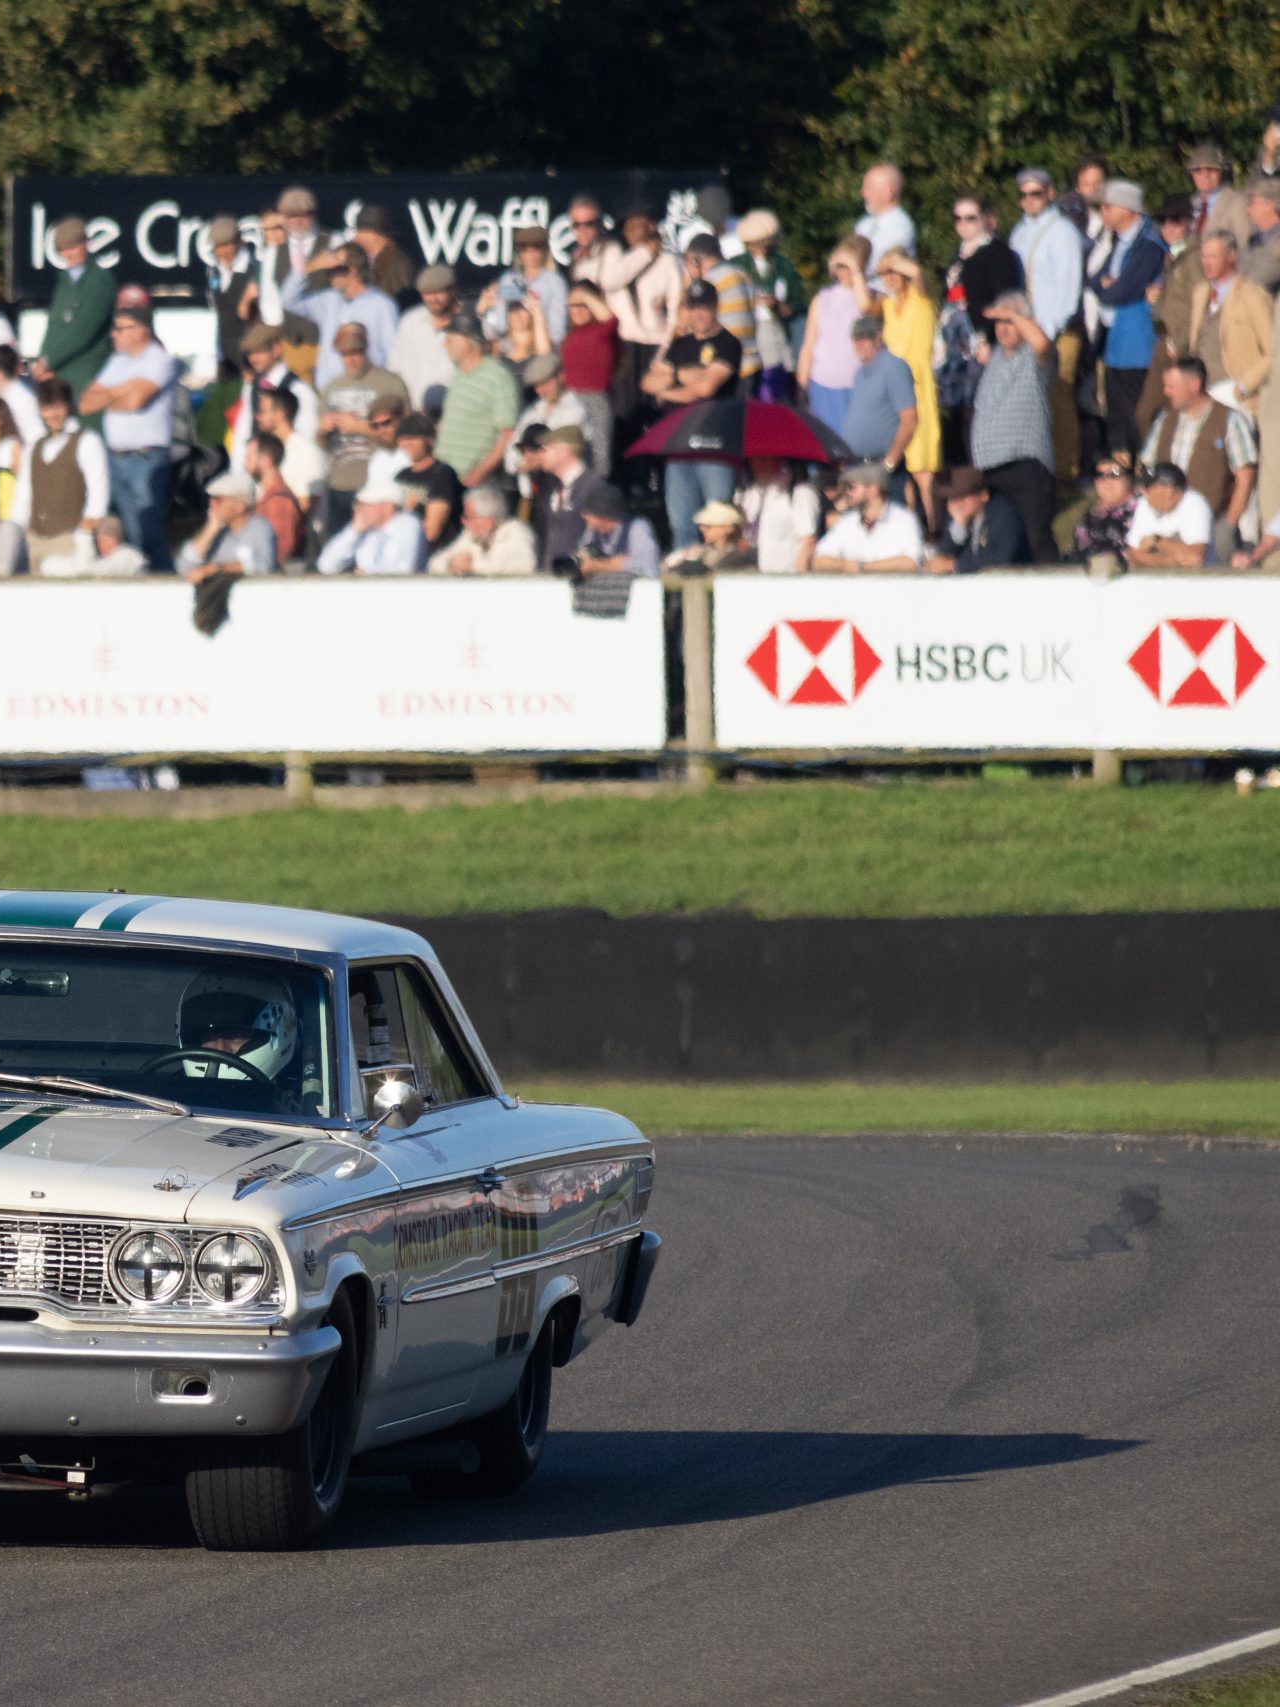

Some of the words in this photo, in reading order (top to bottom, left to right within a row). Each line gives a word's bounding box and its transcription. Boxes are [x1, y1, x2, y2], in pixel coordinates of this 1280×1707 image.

[136, 200, 268, 269] Cra
[408, 197, 615, 266] Waffe
[895, 642, 1009, 683] HSBC
[1019, 641, 1075, 684] UK
[6, 693, 212, 719] EDMISTON
[377, 691, 578, 717] EDMISTON
[441, 1206, 472, 1259] RACING
